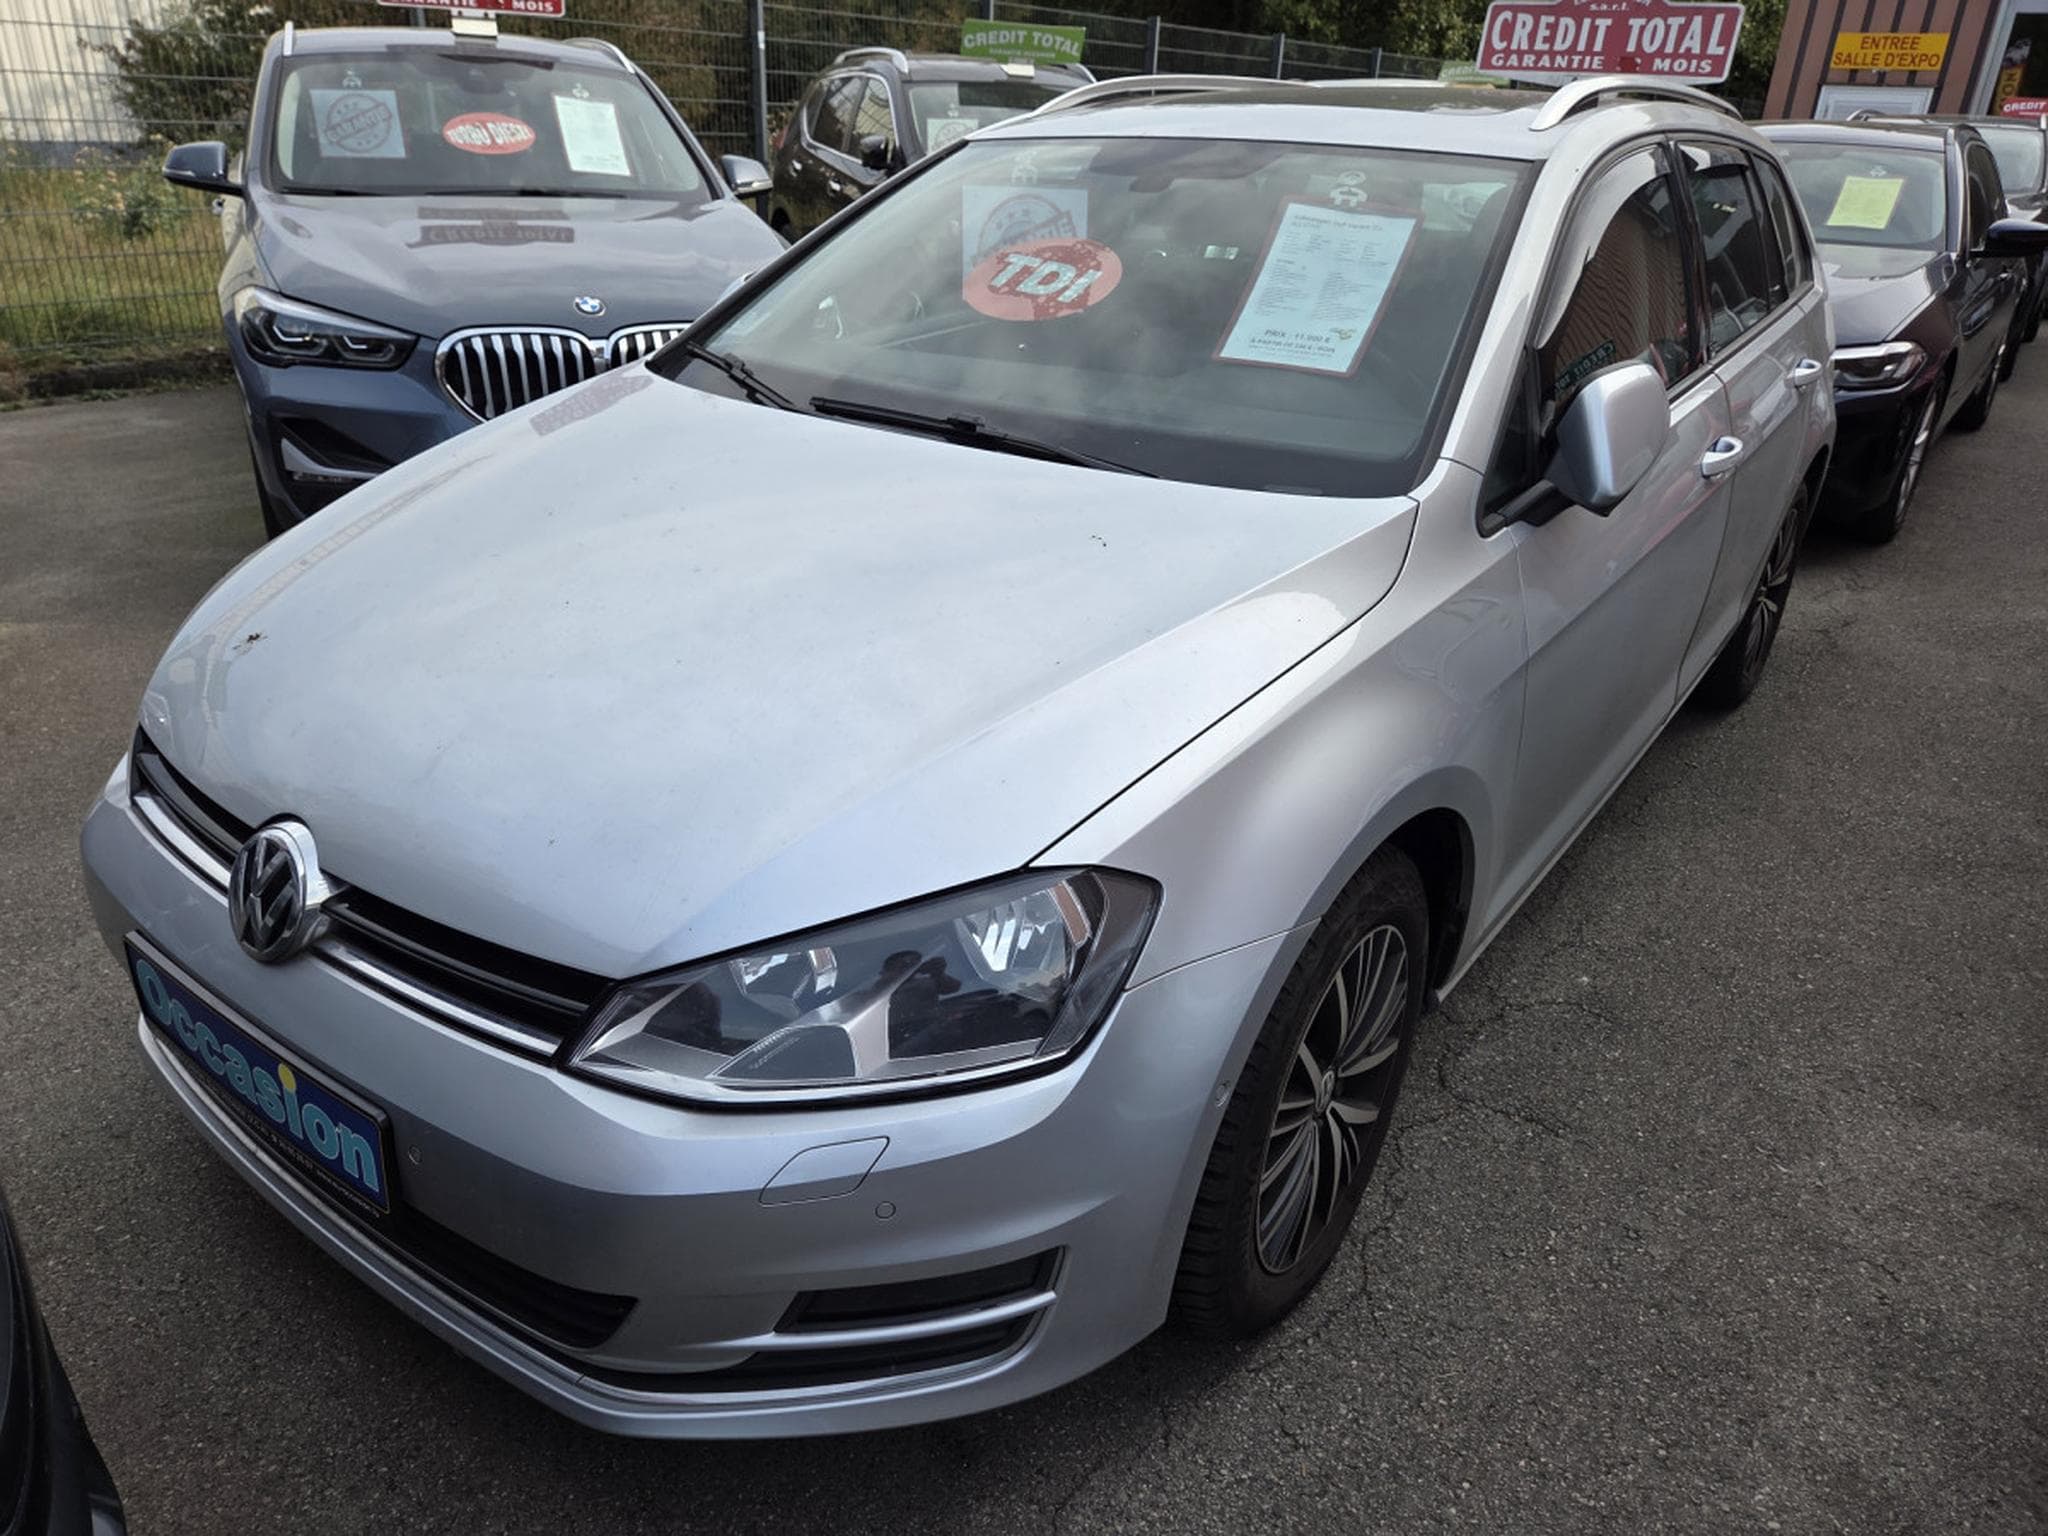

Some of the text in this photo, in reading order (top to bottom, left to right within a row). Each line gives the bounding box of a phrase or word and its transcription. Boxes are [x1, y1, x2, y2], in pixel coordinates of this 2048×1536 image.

[511, 0, 554, 12] MOIS
[1490, 10, 1726, 55] CREDIT TOTAL
[963, 30, 1027, 48] CREDIT
[1032, 31, 1081, 56] TOTAL
[1861, 36, 1922, 50] ENTREE
[1491, 53, 1604, 70] GARANTIE
[1652, 57, 1713, 73] MOIS
[1833, 52, 1940, 67] SALLE D'EXPO
[2003, 101, 2047, 112] CREDIT
[990, 253, 1103, 303] TDI
[135, 959, 380, 1193] Occasion
